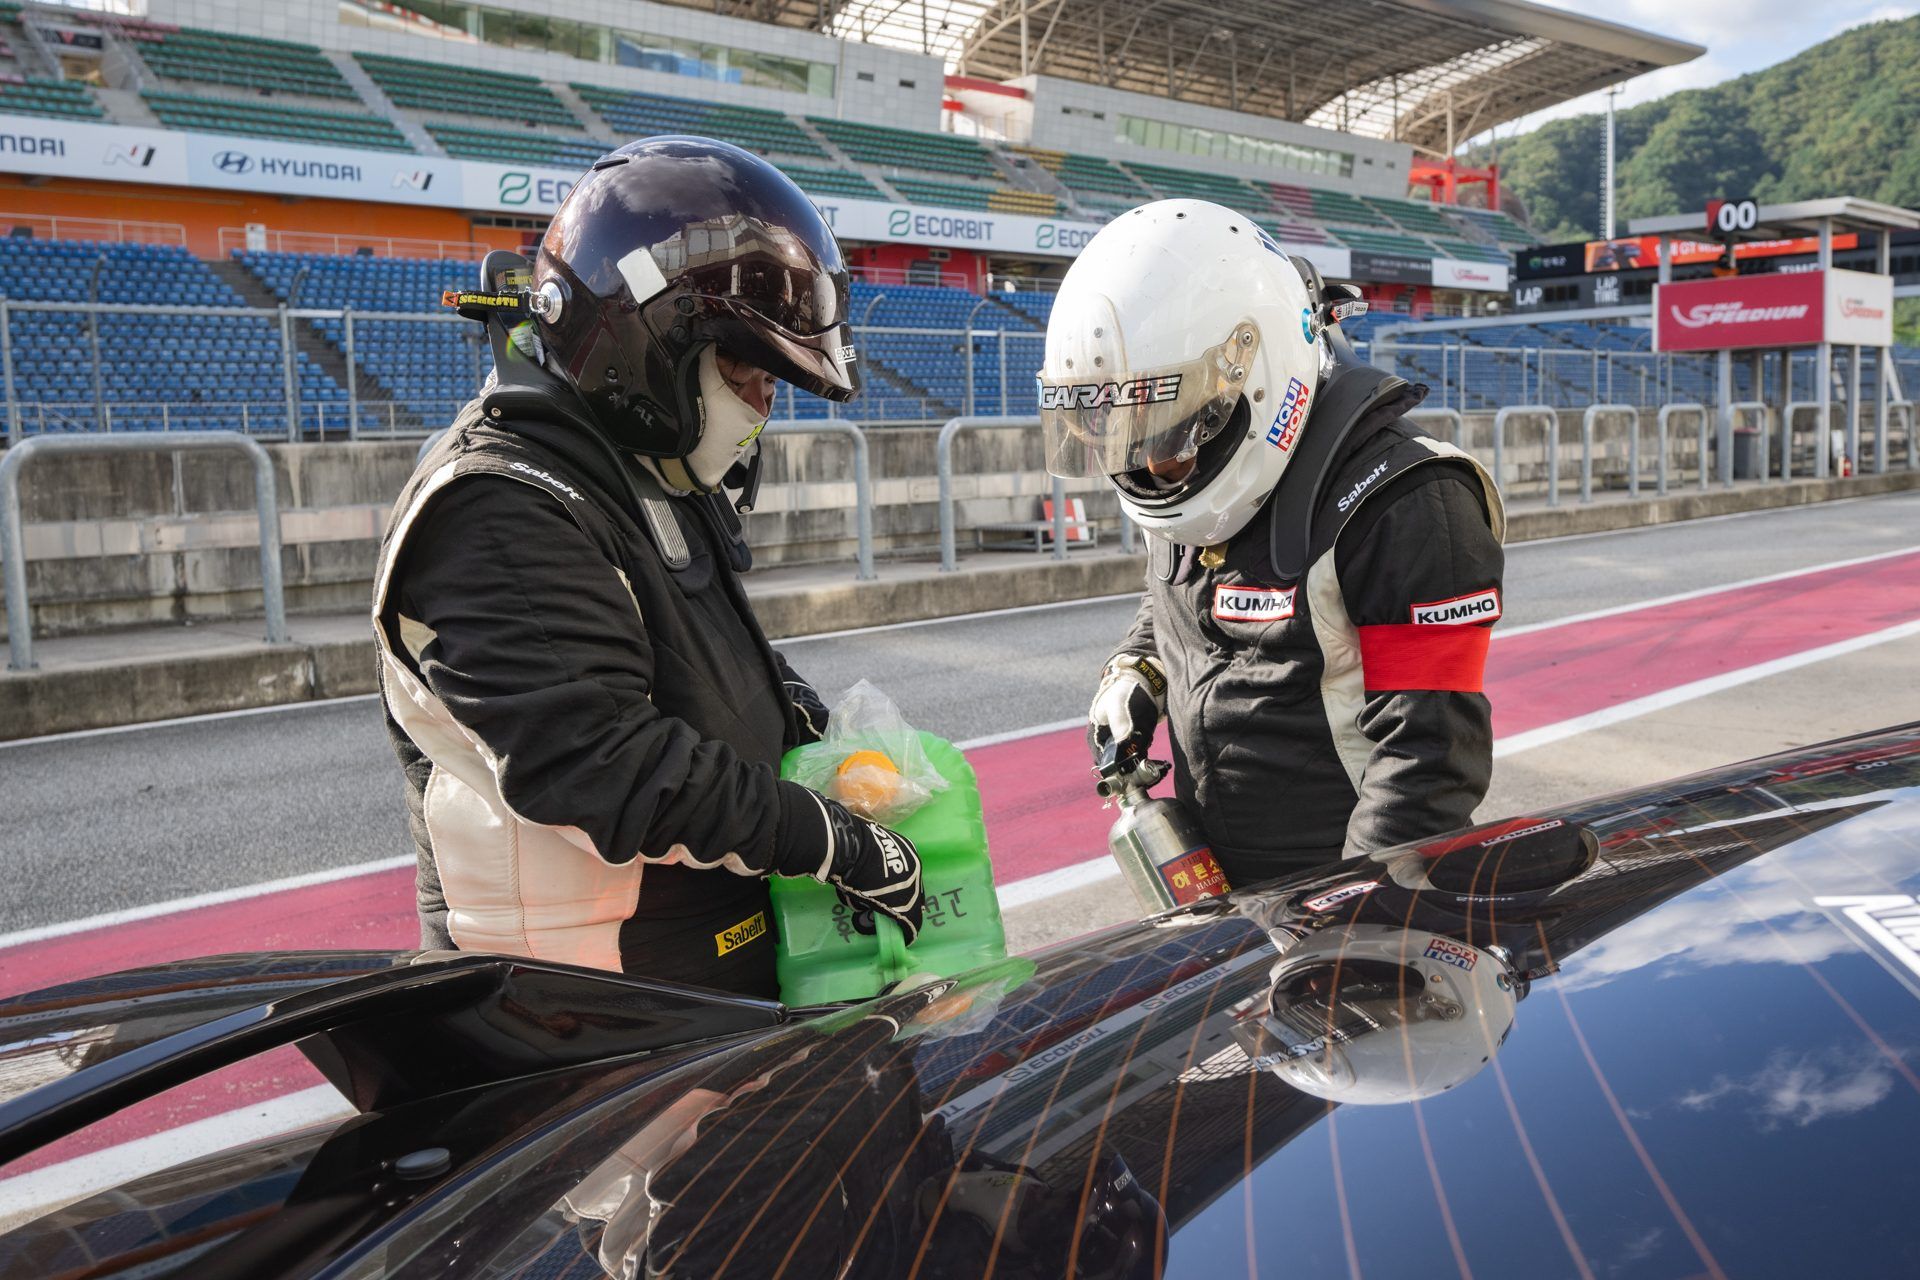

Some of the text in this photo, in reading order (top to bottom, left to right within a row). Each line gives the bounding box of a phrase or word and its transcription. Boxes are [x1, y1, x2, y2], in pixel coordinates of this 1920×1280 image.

[261, 157, 362, 182] HYUNDAI
[914, 214, 995, 241] ECORBIT
[1717, 200, 1758, 231] 00
[1515, 286, 1543, 306] LAP
[1596, 276, 1618, 288] LAP
[1042, 373, 1183, 410] GARAGE
[1268, 380, 1301, 443] LIQUI
[1279, 384, 1308, 449] MOLY
[1337, 460, 1389, 512] Sabelt
[1219, 594, 1293, 611] KUMHO
[1417, 597, 1496, 625] KUMHO
[722, 916, 766, 950] Sabelt
